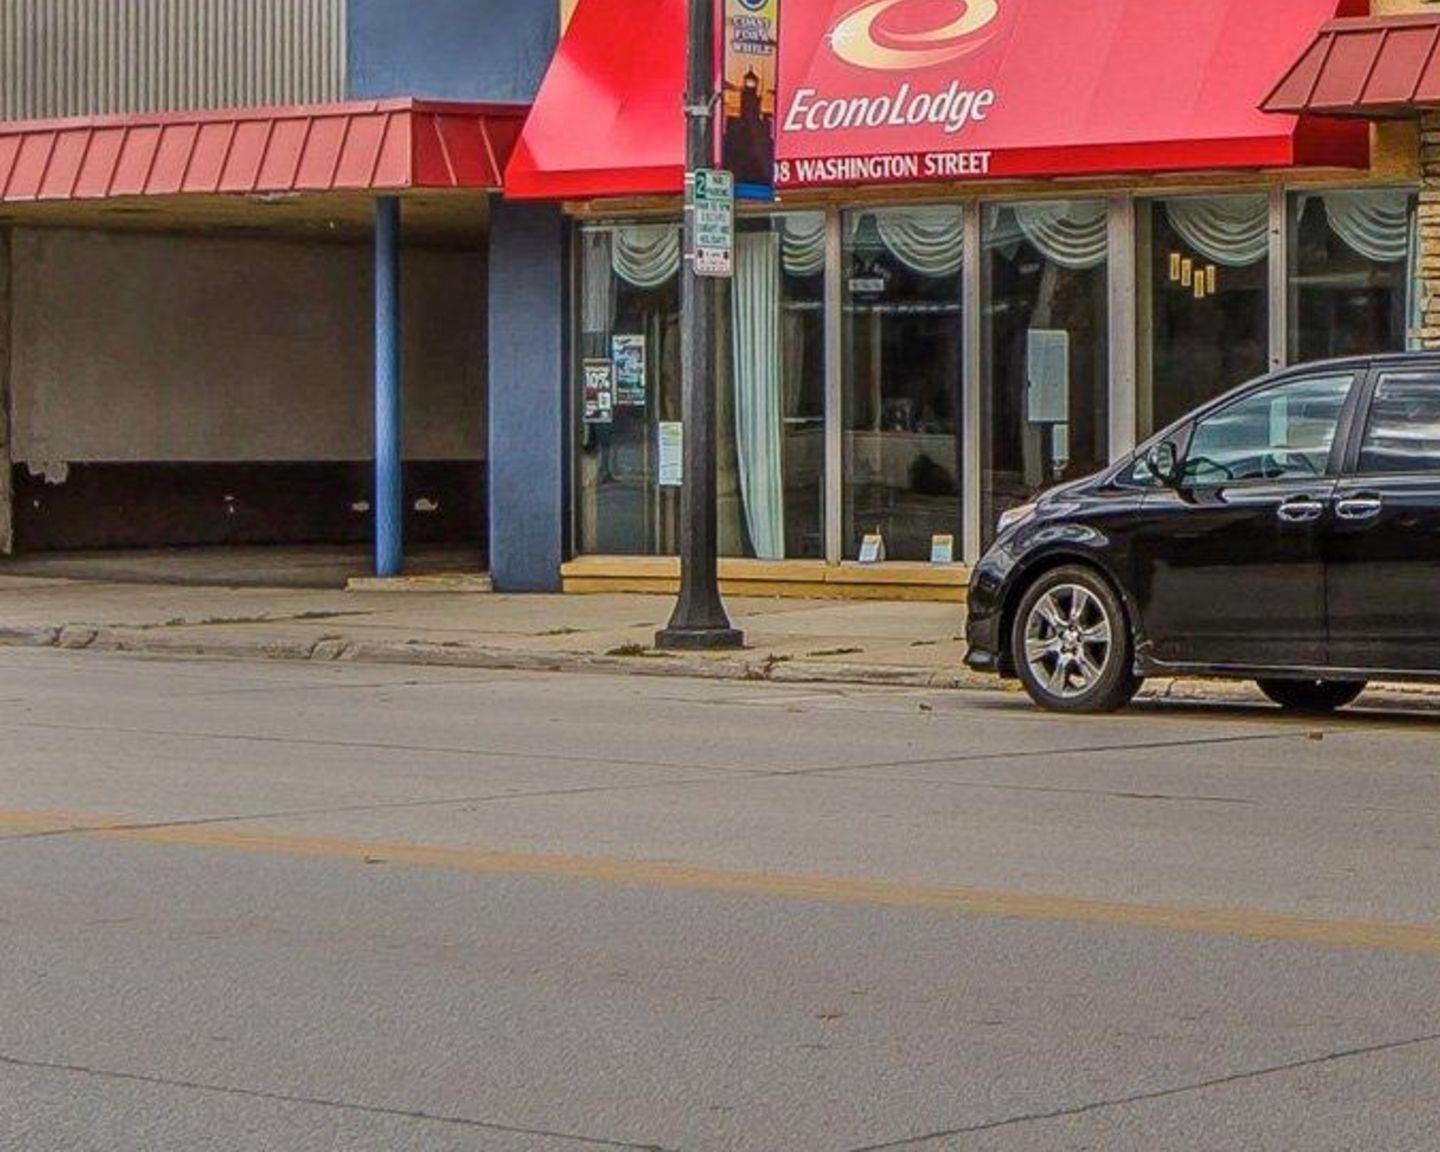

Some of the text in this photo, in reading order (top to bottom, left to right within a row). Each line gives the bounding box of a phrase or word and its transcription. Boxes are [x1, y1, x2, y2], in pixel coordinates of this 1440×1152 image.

[783, 80, 995, 133] EconoLodge
[795, 155, 918, 181] WASHINGTON
[924, 152, 991, 175] STREET
